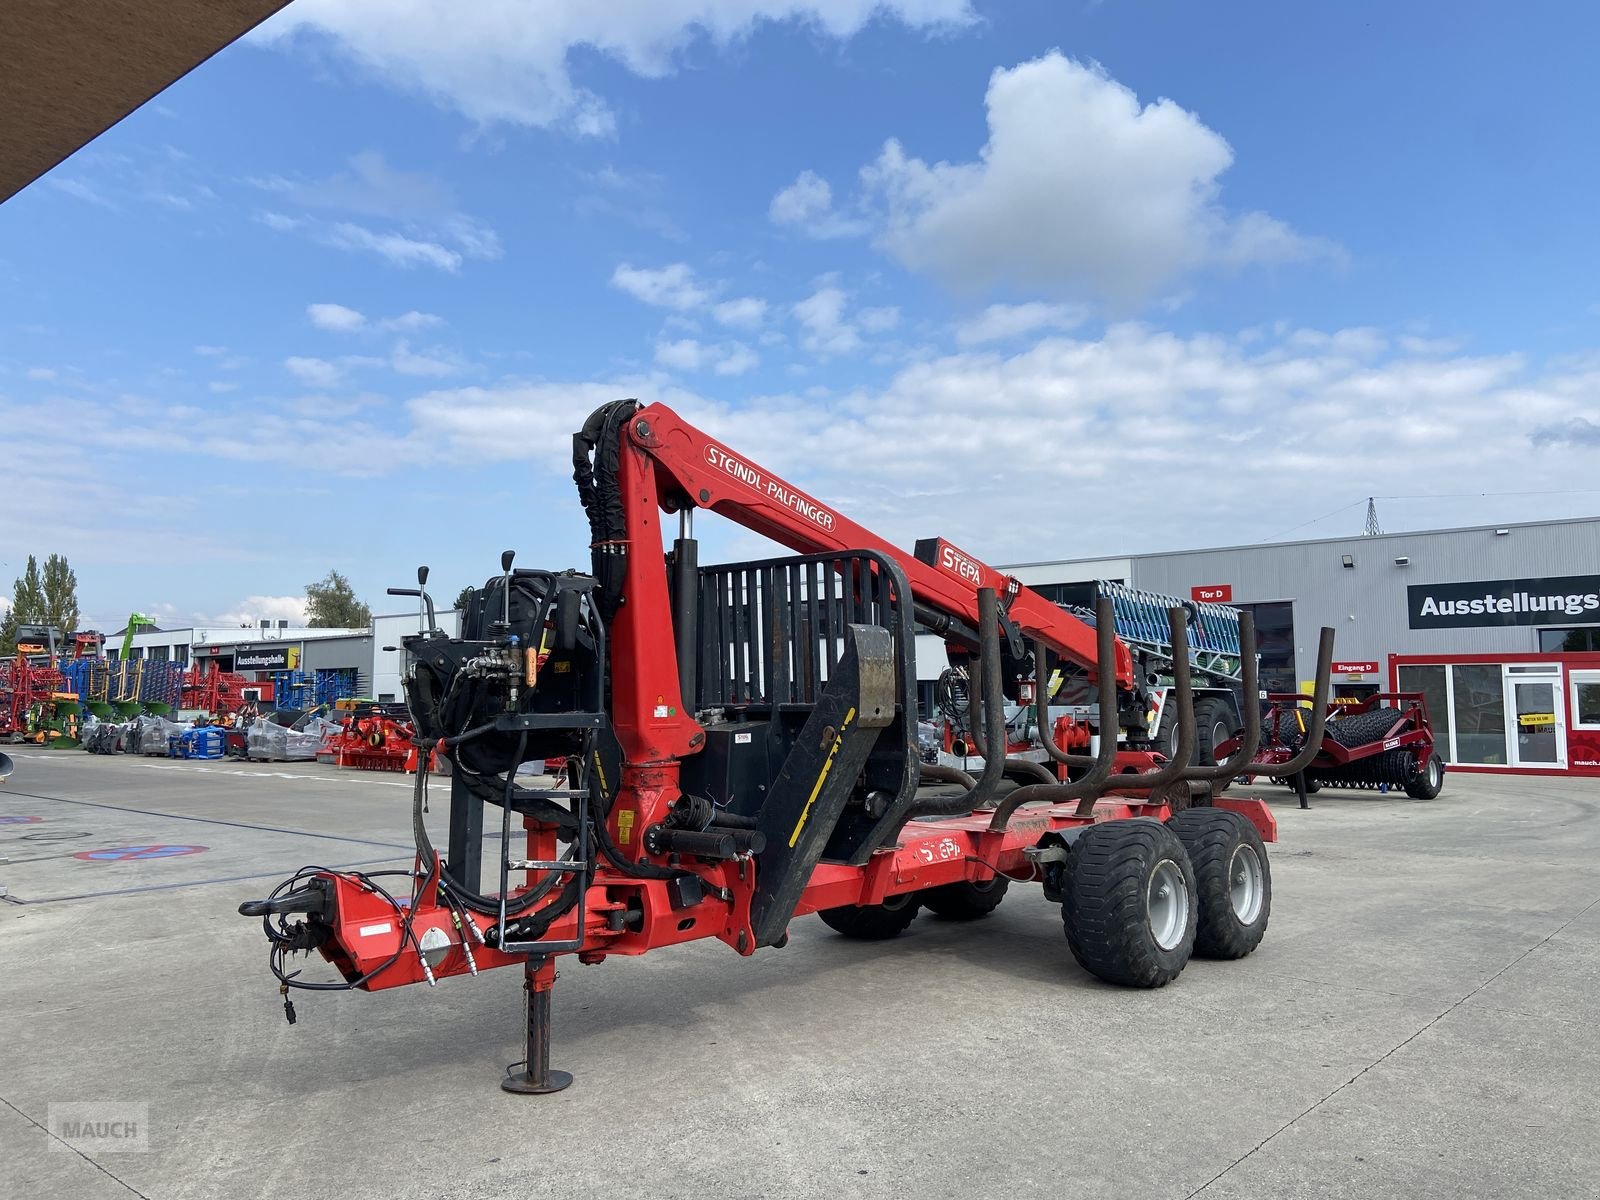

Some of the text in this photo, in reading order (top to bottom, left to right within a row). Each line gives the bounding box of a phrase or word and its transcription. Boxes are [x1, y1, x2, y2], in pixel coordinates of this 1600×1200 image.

[708, 447, 832, 529] STEINDL-PALFINGER
[943, 547, 980, 585] STEPA
[1200, 590, 1223, 599] Tor D
[1420, 589, 1600, 615] Ausstellungs
[237, 654, 284, 666] Ausstellungshalle
[1338, 664, 1365, 672] Eingang
